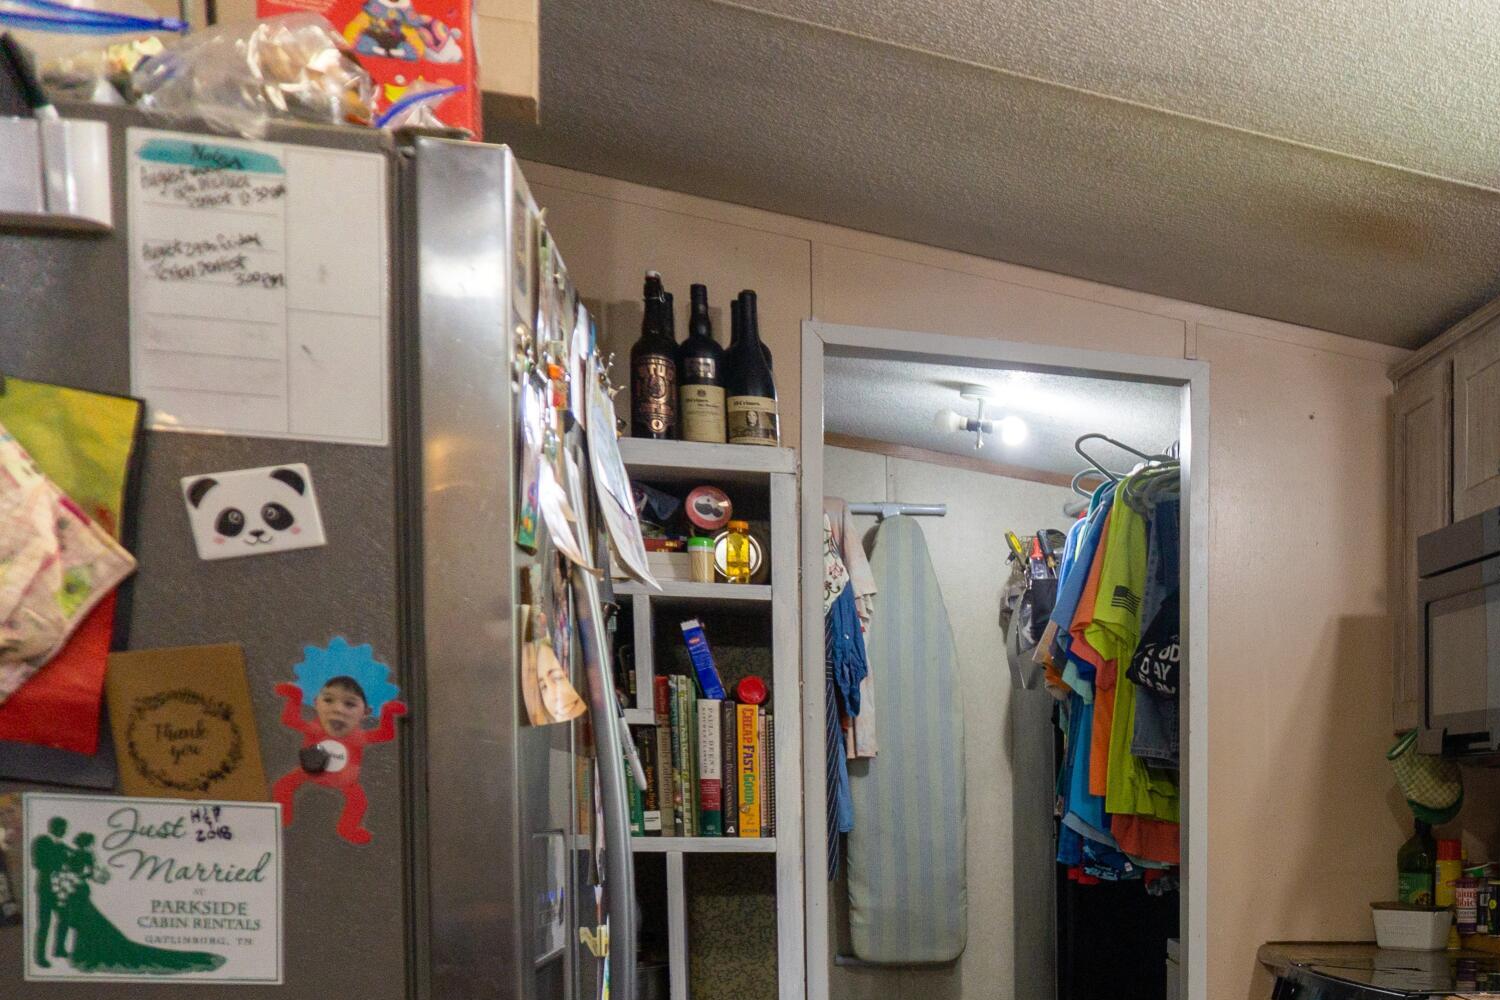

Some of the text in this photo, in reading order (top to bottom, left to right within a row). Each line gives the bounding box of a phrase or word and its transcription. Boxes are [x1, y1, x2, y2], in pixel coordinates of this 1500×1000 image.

[155, 720, 206, 741] Thank
[170, 744, 199, 765] you
[102, 807, 185, 850] Just
[196, 826, 232, 842] 2018
[108, 849, 271, 883] Married
[151, 900, 248, 916] PARKSIDE
[137, 916, 261, 930] CABIN RENTALS
[237, 937, 254, 945] TN
